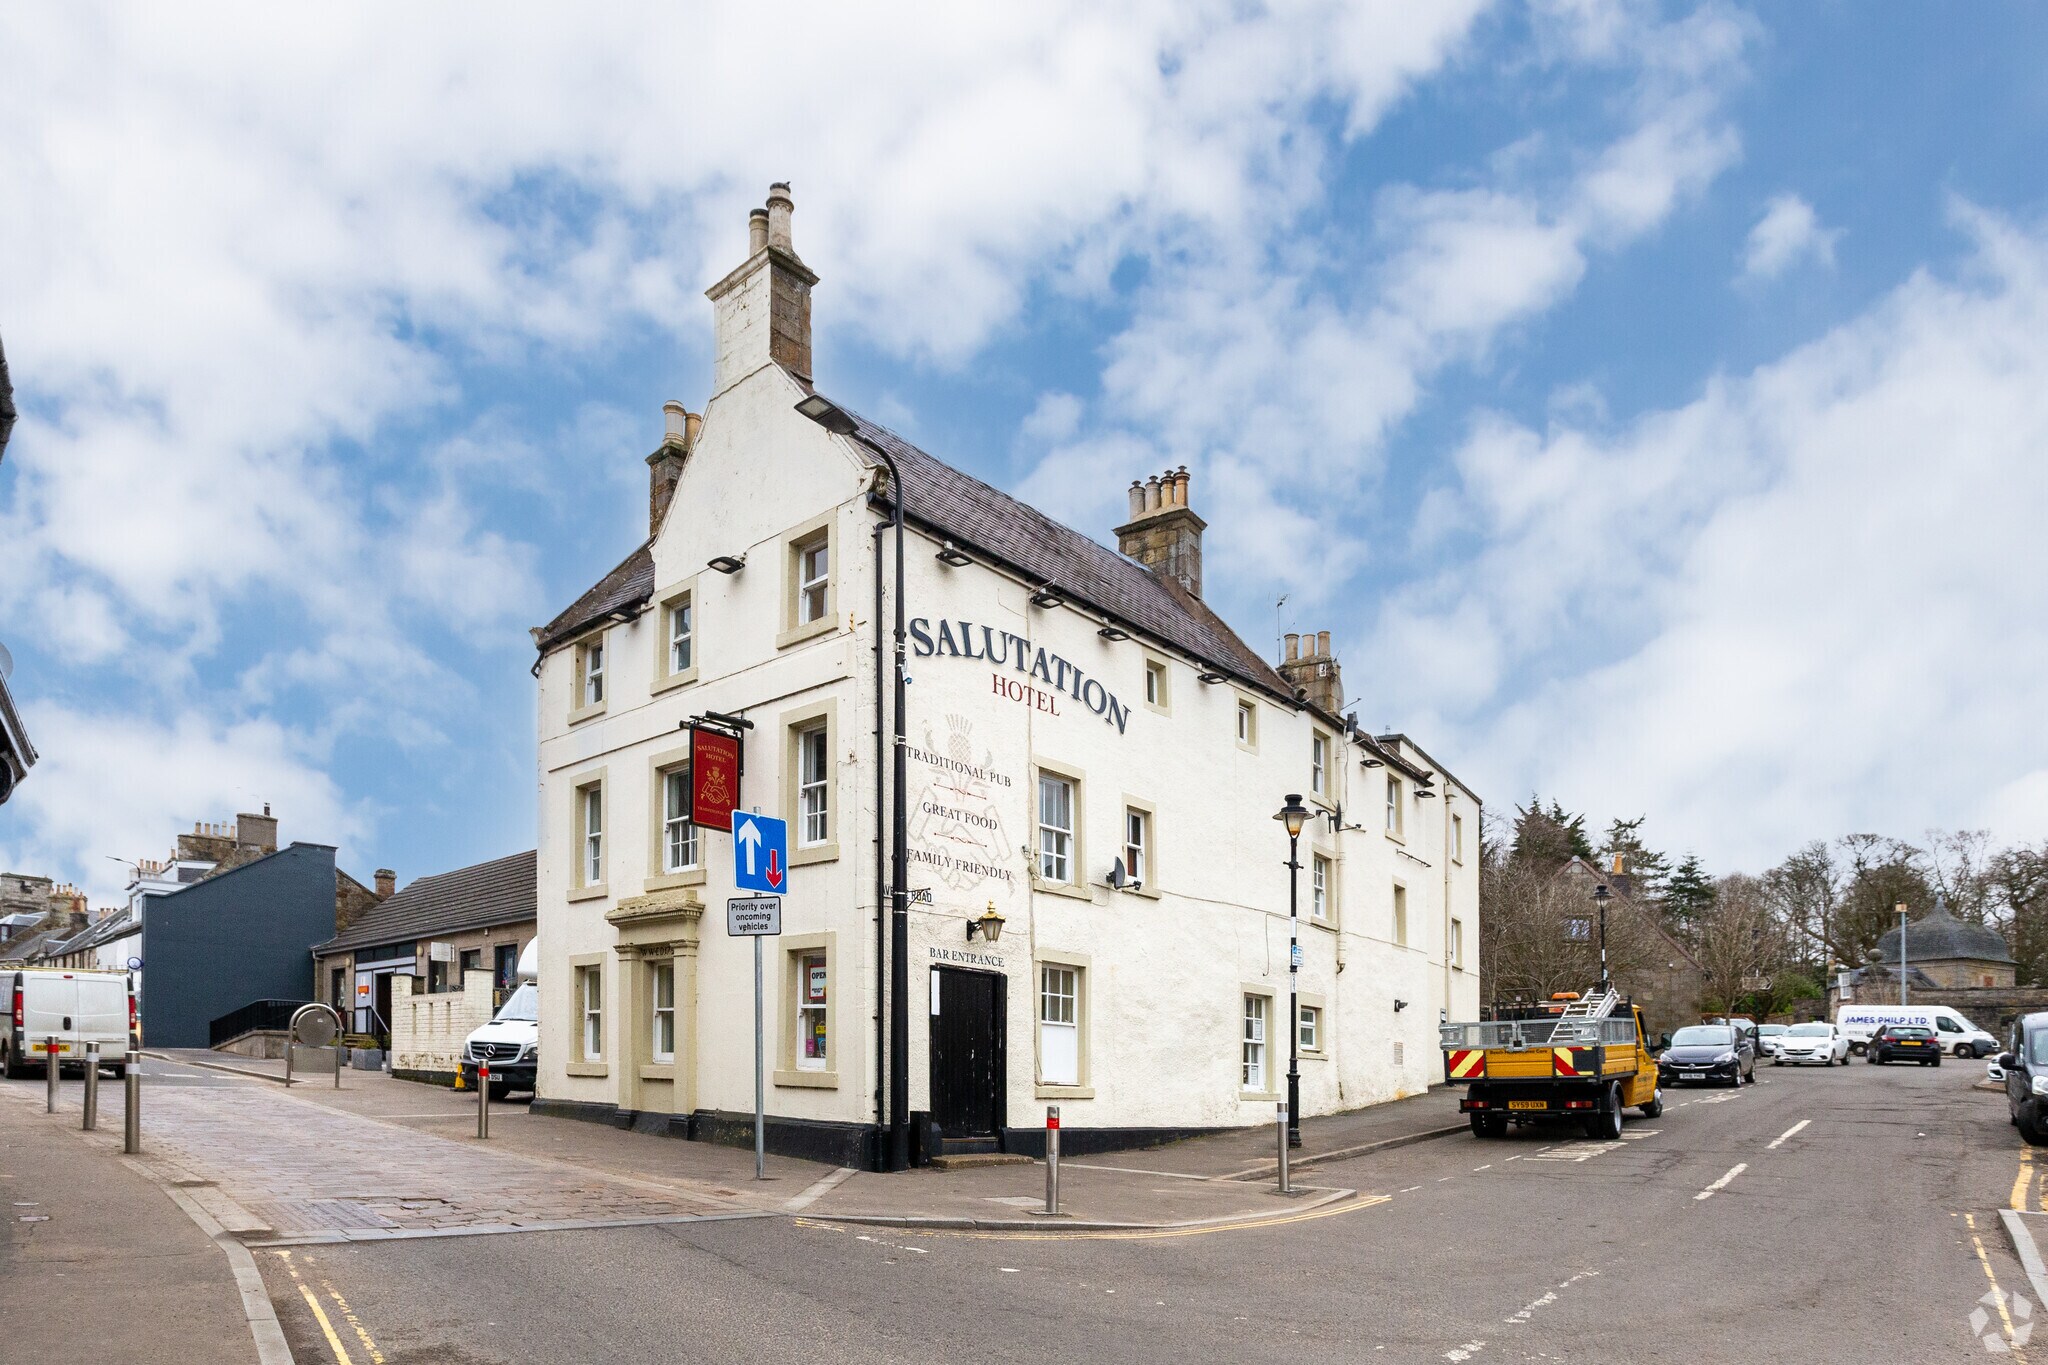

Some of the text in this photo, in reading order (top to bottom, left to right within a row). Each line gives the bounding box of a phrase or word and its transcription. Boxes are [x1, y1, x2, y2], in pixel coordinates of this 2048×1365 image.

[909, 617, 1132, 735] SALUTATION
[992, 673, 1060, 717] HOTEL
[696, 744, 735, 759] SALUTATION
[705, 752, 727, 763] HOTEL
[905, 746, 1011, 788] TRADITIONAL PUB
[922, 801, 998, 831] GREAT FOOD
[906, 848, 1012, 881] FAMILY FRIENDLY
[911, 890, 932, 903] ROAD
[731, 902, 758, 912] Priority
[735, 911, 771, 921] oncoming
[738, 922, 769, 931] vehicles
[929, 947, 1005, 967] BAR ENTRANCE
[1845, 1016, 1875, 1024] JAMES
[1877, 1016, 1906, 1025] PHILP
[1511, 1101, 1545, 1109] SY59 UXN
